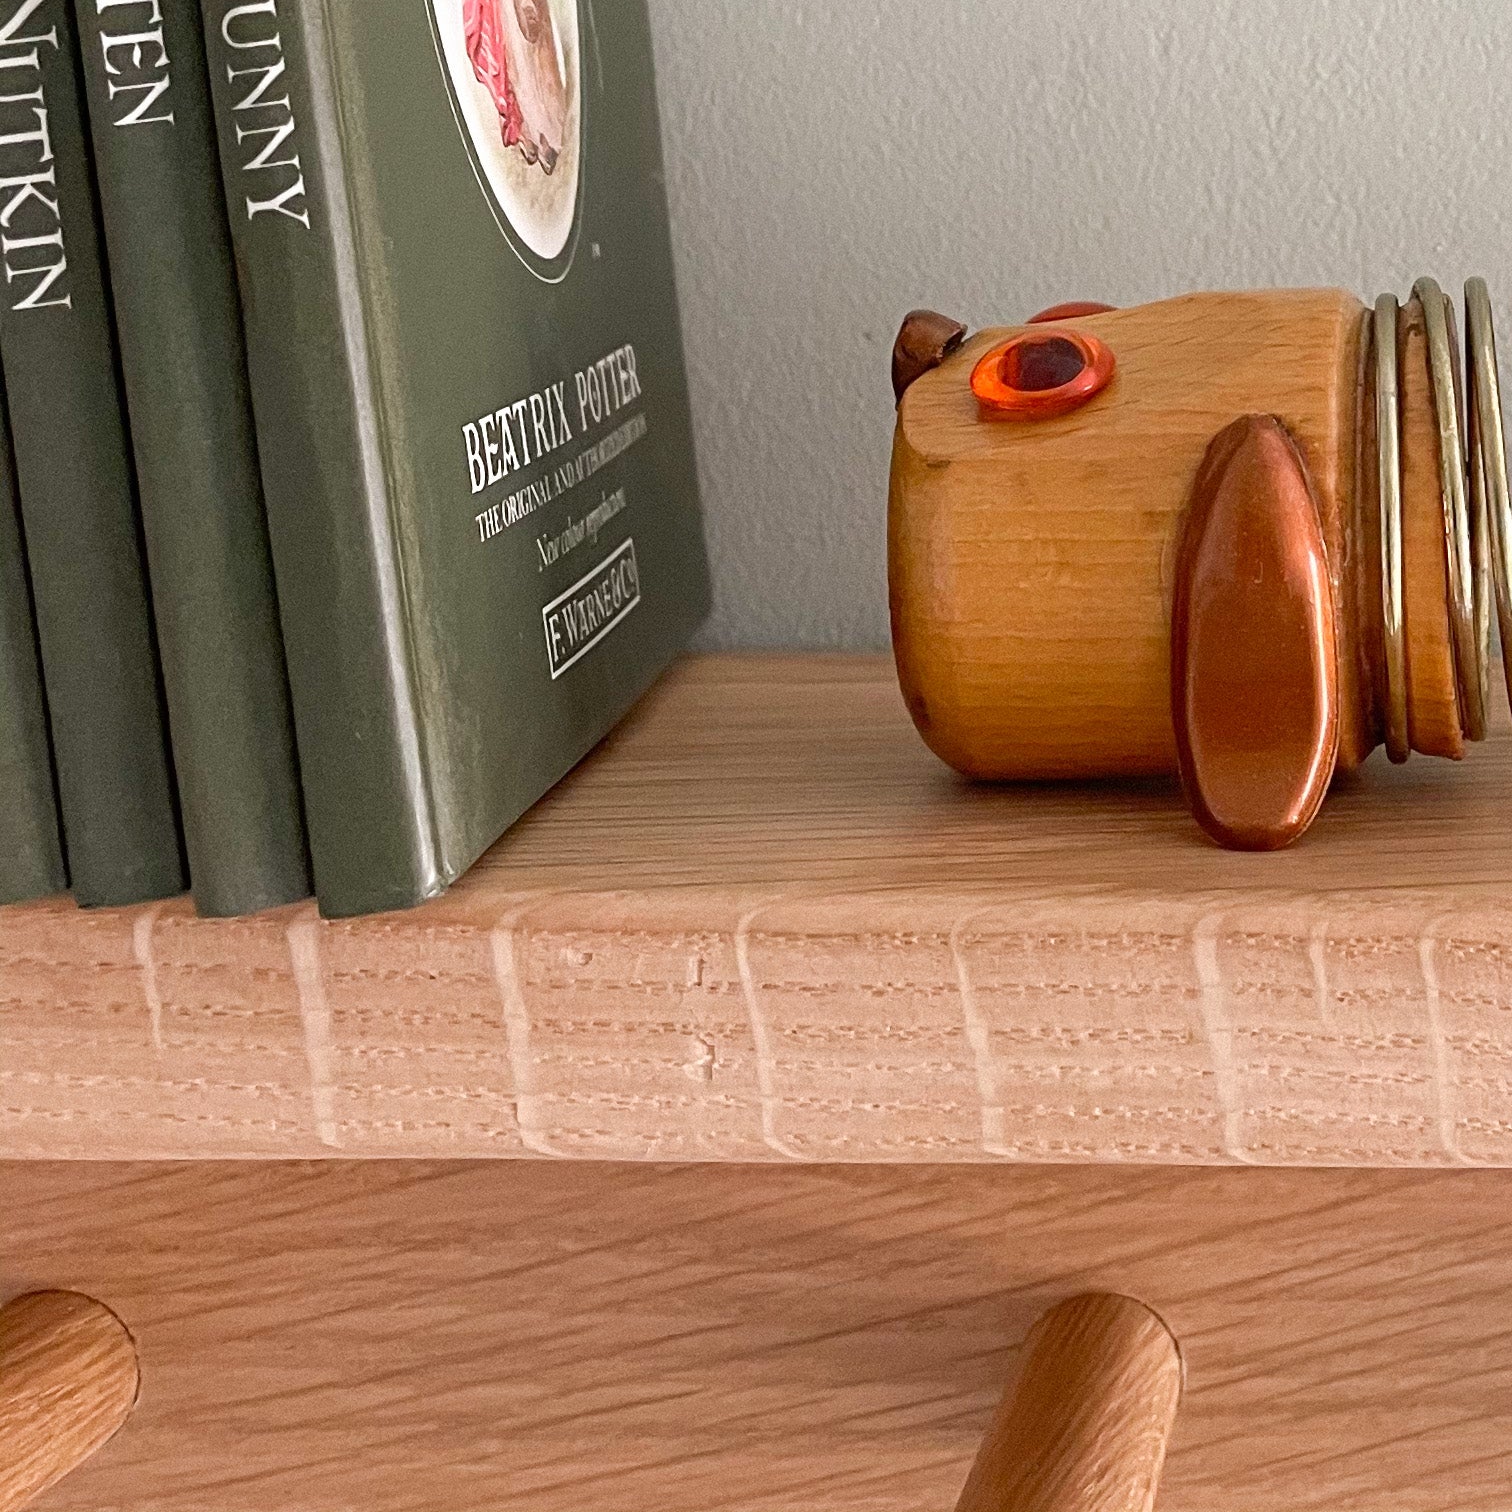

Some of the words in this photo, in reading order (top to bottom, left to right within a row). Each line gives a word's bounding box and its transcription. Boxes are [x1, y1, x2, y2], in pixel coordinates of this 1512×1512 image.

[462, 381, 573, 495] BEATRIX
[574, 343, 642, 432] POTTER
[475, 505, 502, 542] THE
[502, 475, 552, 528] ORIGINAL
